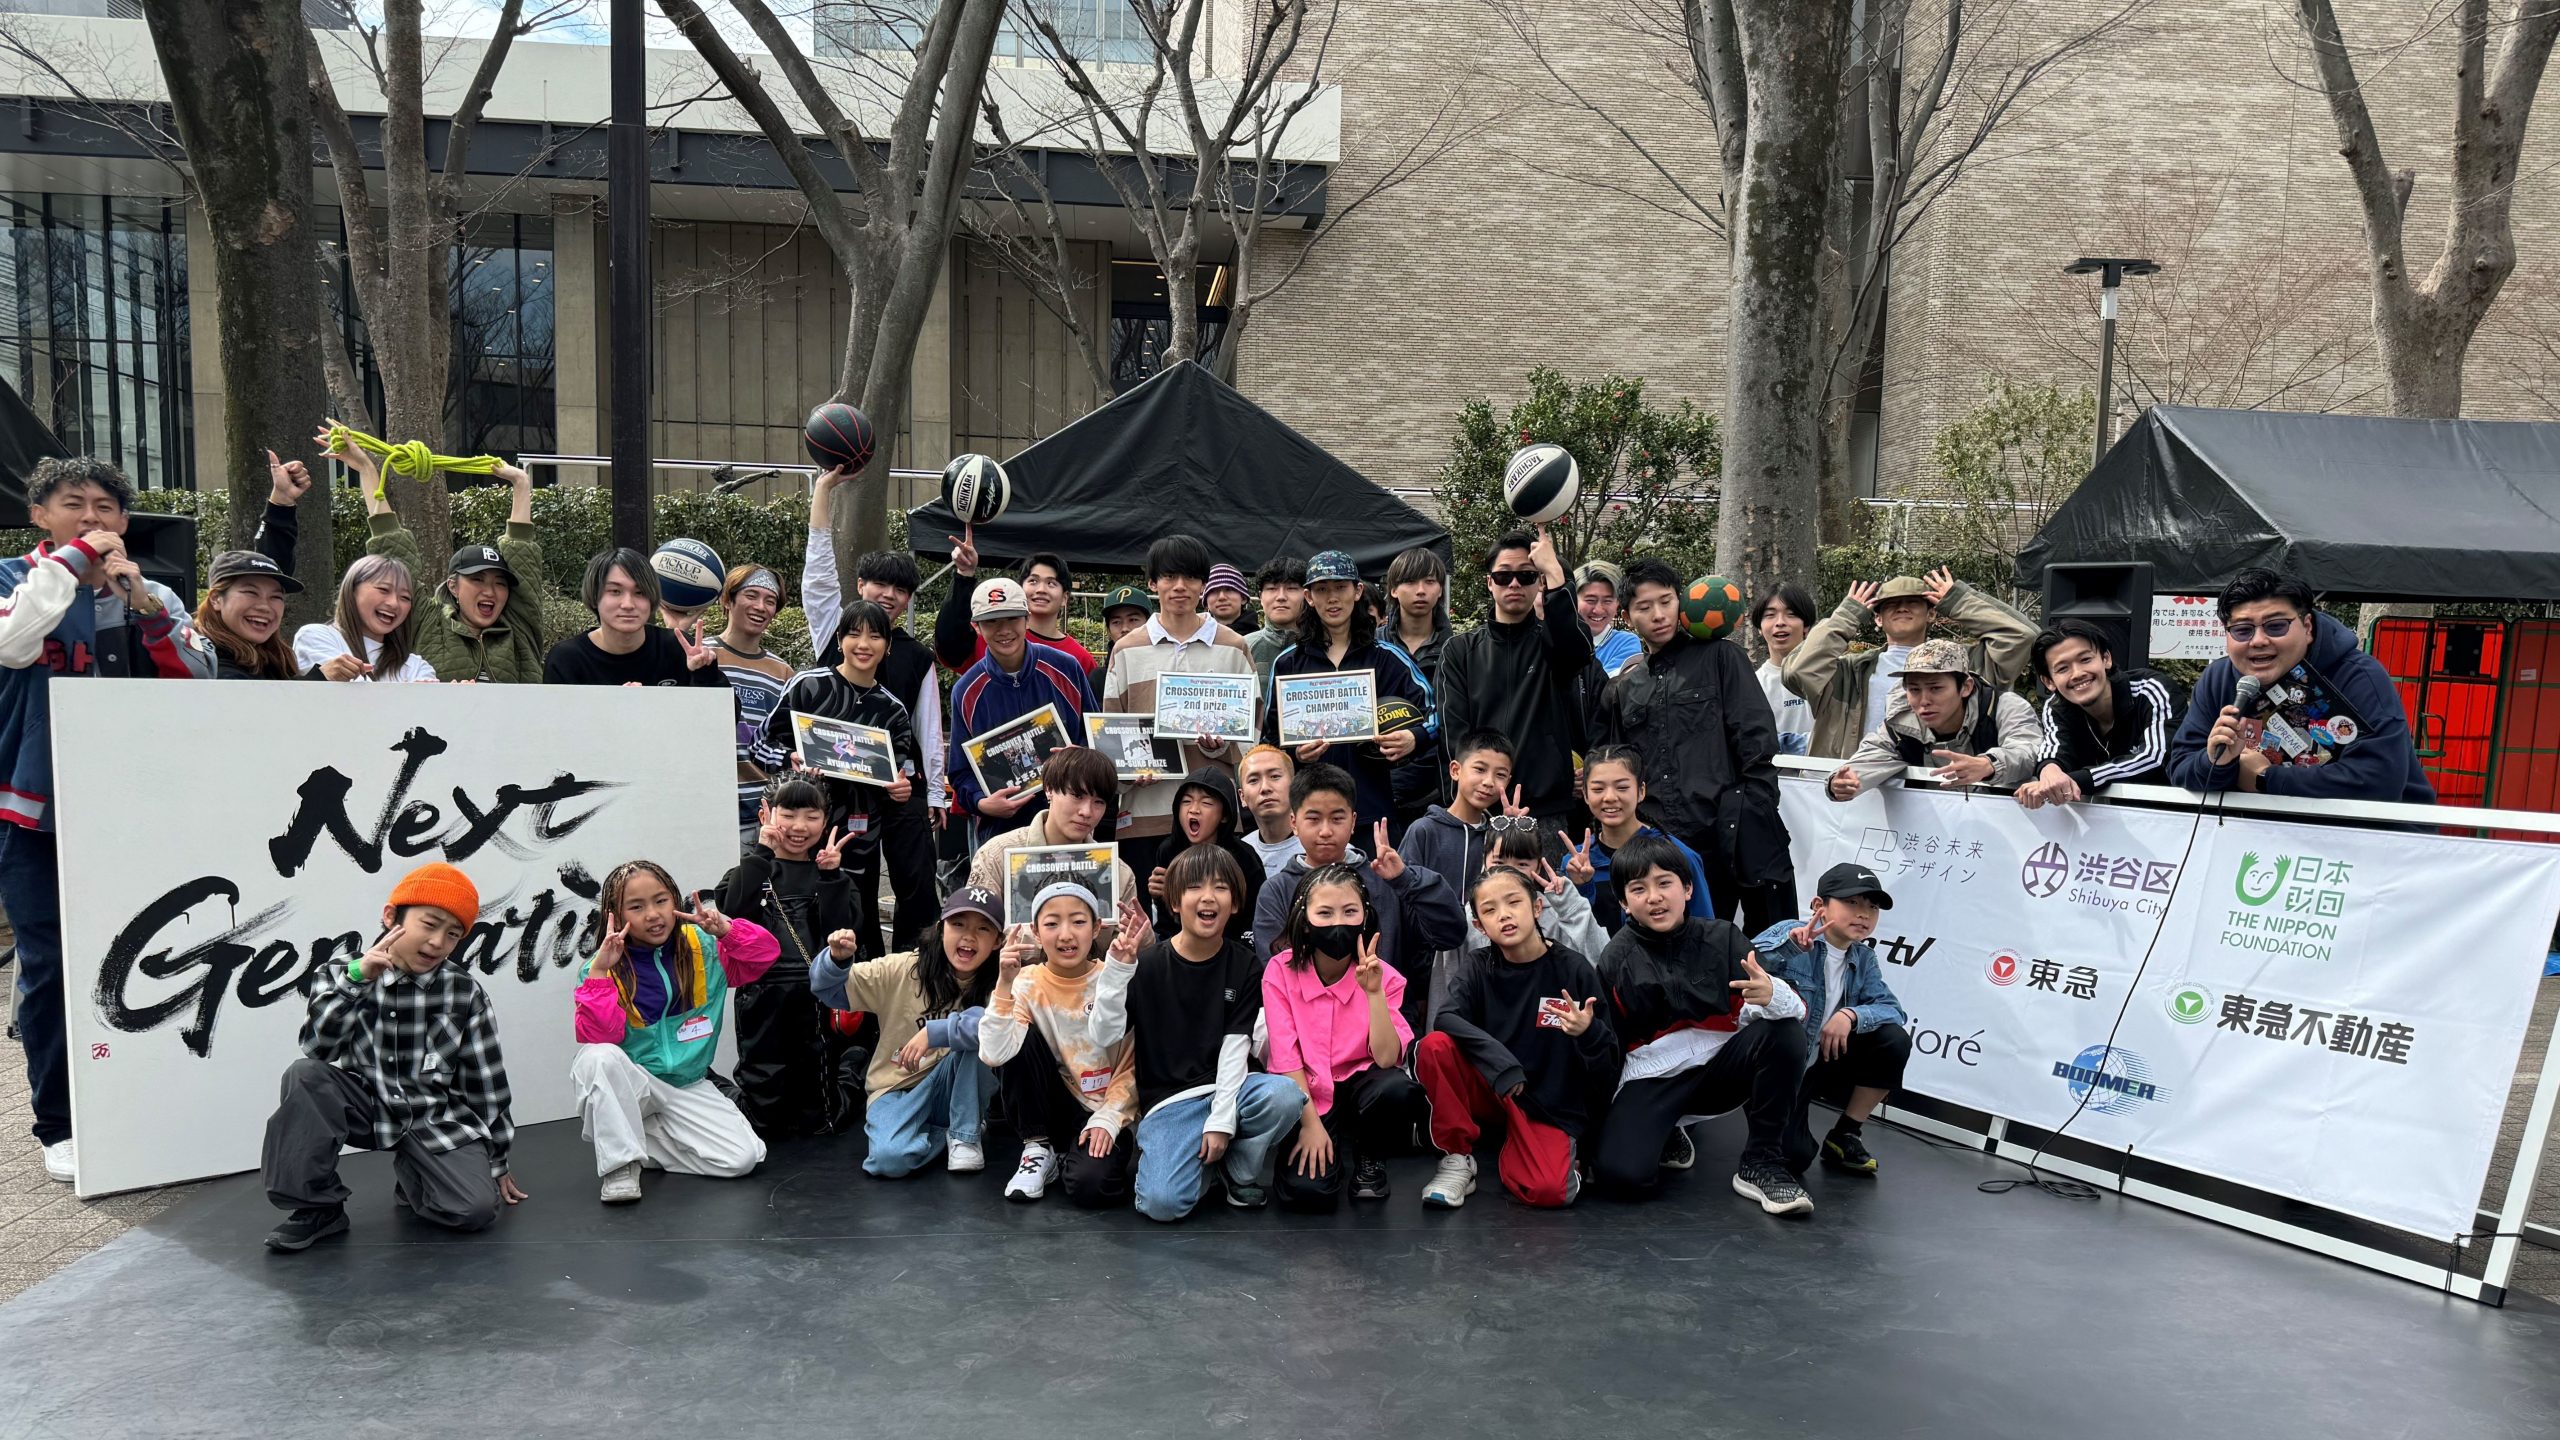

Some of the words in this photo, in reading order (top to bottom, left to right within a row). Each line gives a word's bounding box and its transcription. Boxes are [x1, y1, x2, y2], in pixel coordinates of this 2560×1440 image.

[958, 475, 973, 512] TACHIKARA
[660, 556, 702, 575] PICKUP
[1165, 687, 1215, 698] CROSSOVER
[1217, 688, 1248, 699] BATTLE
[1184, 700, 1201, 710] 2nd
[1203, 701, 1227, 711] prize
[1286, 688, 1337, 701] CROSSOVER
[1337, 686, 1368, 698] BATTLE
[1306, 702, 1349, 713] CHAMPION
[986, 735, 1022, 758] CROSSOVER
[1022, 726, 1046, 742] BATTLE
[1104, 727, 1140, 735] CROSSOVER
[1141, 727, 1154, 735] BAT
[2268, 717, 2303, 752] SUPREME
[852, 763, 873, 774] PRIZE
[1148, 759, 1168, 768] PRIZE
[268, 726, 631, 878] Next
[1902, 832, 1984, 860] 渋谷未来
[1026, 861, 1069, 873] CROSSOVER
[1071, 860, 1098, 872] BATTLE
[1898, 859, 1976, 883] デザイン
[2074, 852, 2178, 895] 渋谷区
[2292, 856, 2354, 886] 日本
[969, 888, 988, 904] NY
[2068, 888, 2129, 913] Shibuya
[2136, 899, 2168, 920] City
[2285, 886, 2346, 918] 財団
[2227, 911, 2260, 929] THE
[2263, 916, 2337, 940] NIPPON
[2220, 931, 2332, 962] FOUNDATION
[2025, 958, 2099, 1000] 東急
[1910, 1018, 1985, 1066] ioré
[2217, 994, 2415, 1065] 東急不動産
[2052, 1061, 2156, 1101] BOOMER
